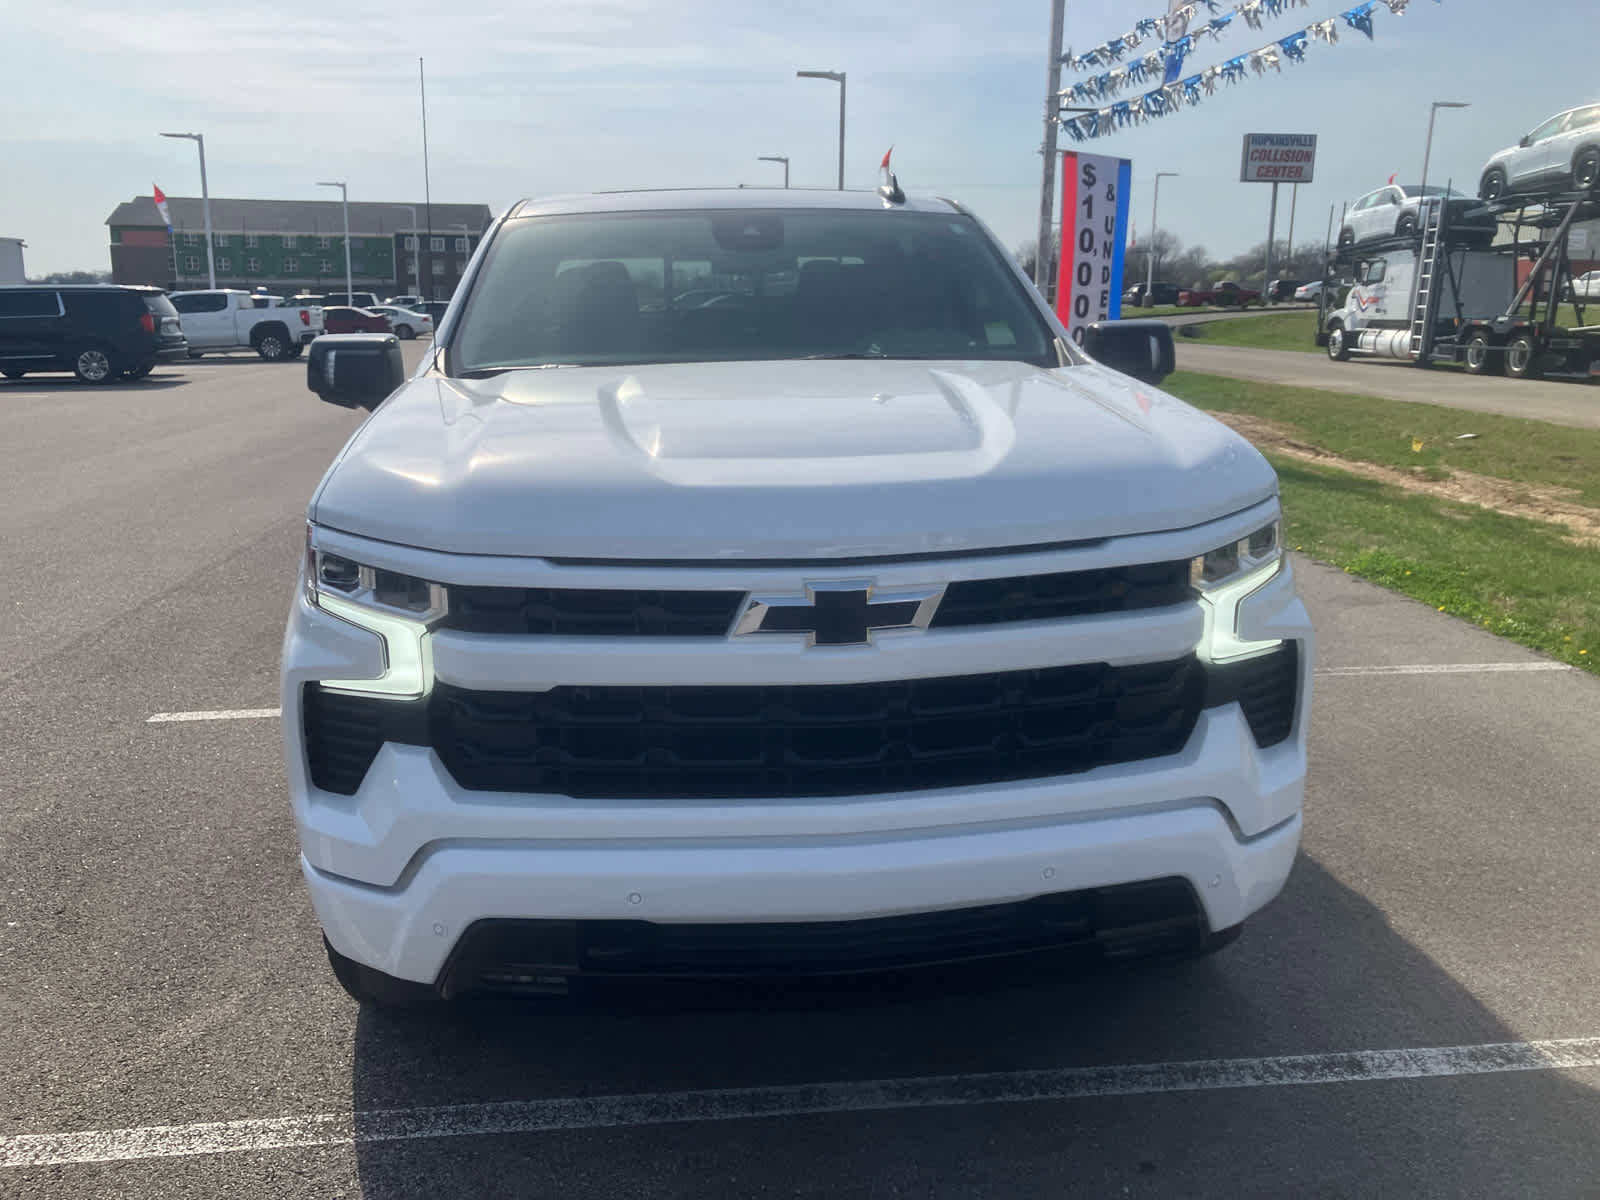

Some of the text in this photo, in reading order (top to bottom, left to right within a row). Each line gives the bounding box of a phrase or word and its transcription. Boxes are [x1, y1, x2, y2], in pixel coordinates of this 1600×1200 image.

[1250, 149, 1313, 162] COLLISION
[1256, 166, 1304, 178] CENTER
[1106, 183, 1115, 202] &
